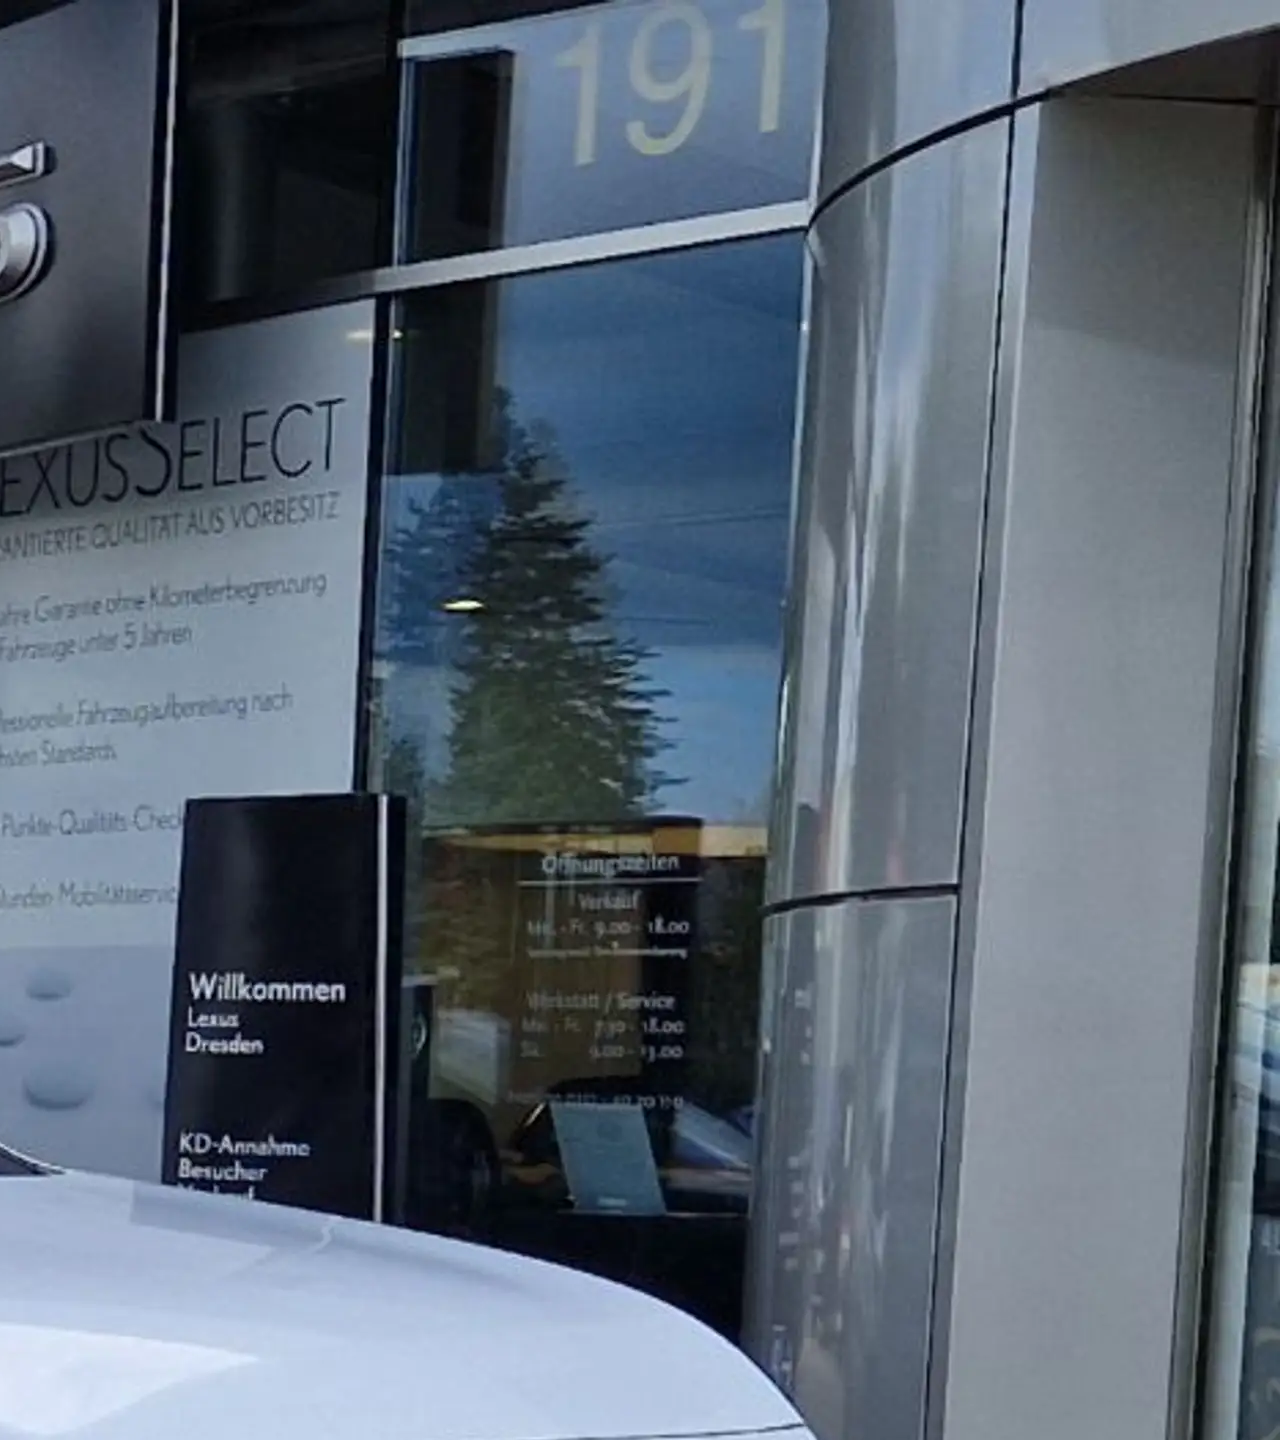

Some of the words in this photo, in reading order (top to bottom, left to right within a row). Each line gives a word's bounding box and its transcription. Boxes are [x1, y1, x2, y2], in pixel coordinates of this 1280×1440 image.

[555, 0, 787, 166] 191
[184, 506, 225, 536] AUS
[229, 491, 341, 532] VORBESITZ
[189, 971, 346, 1003] Willkommen
[187, 1005, 240, 1028] Lexus
[186, 1031, 264, 1054] Dresden
[179, 1131, 311, 1157] KD-Annahme
[178, 1156, 269, 1182] Besucher
